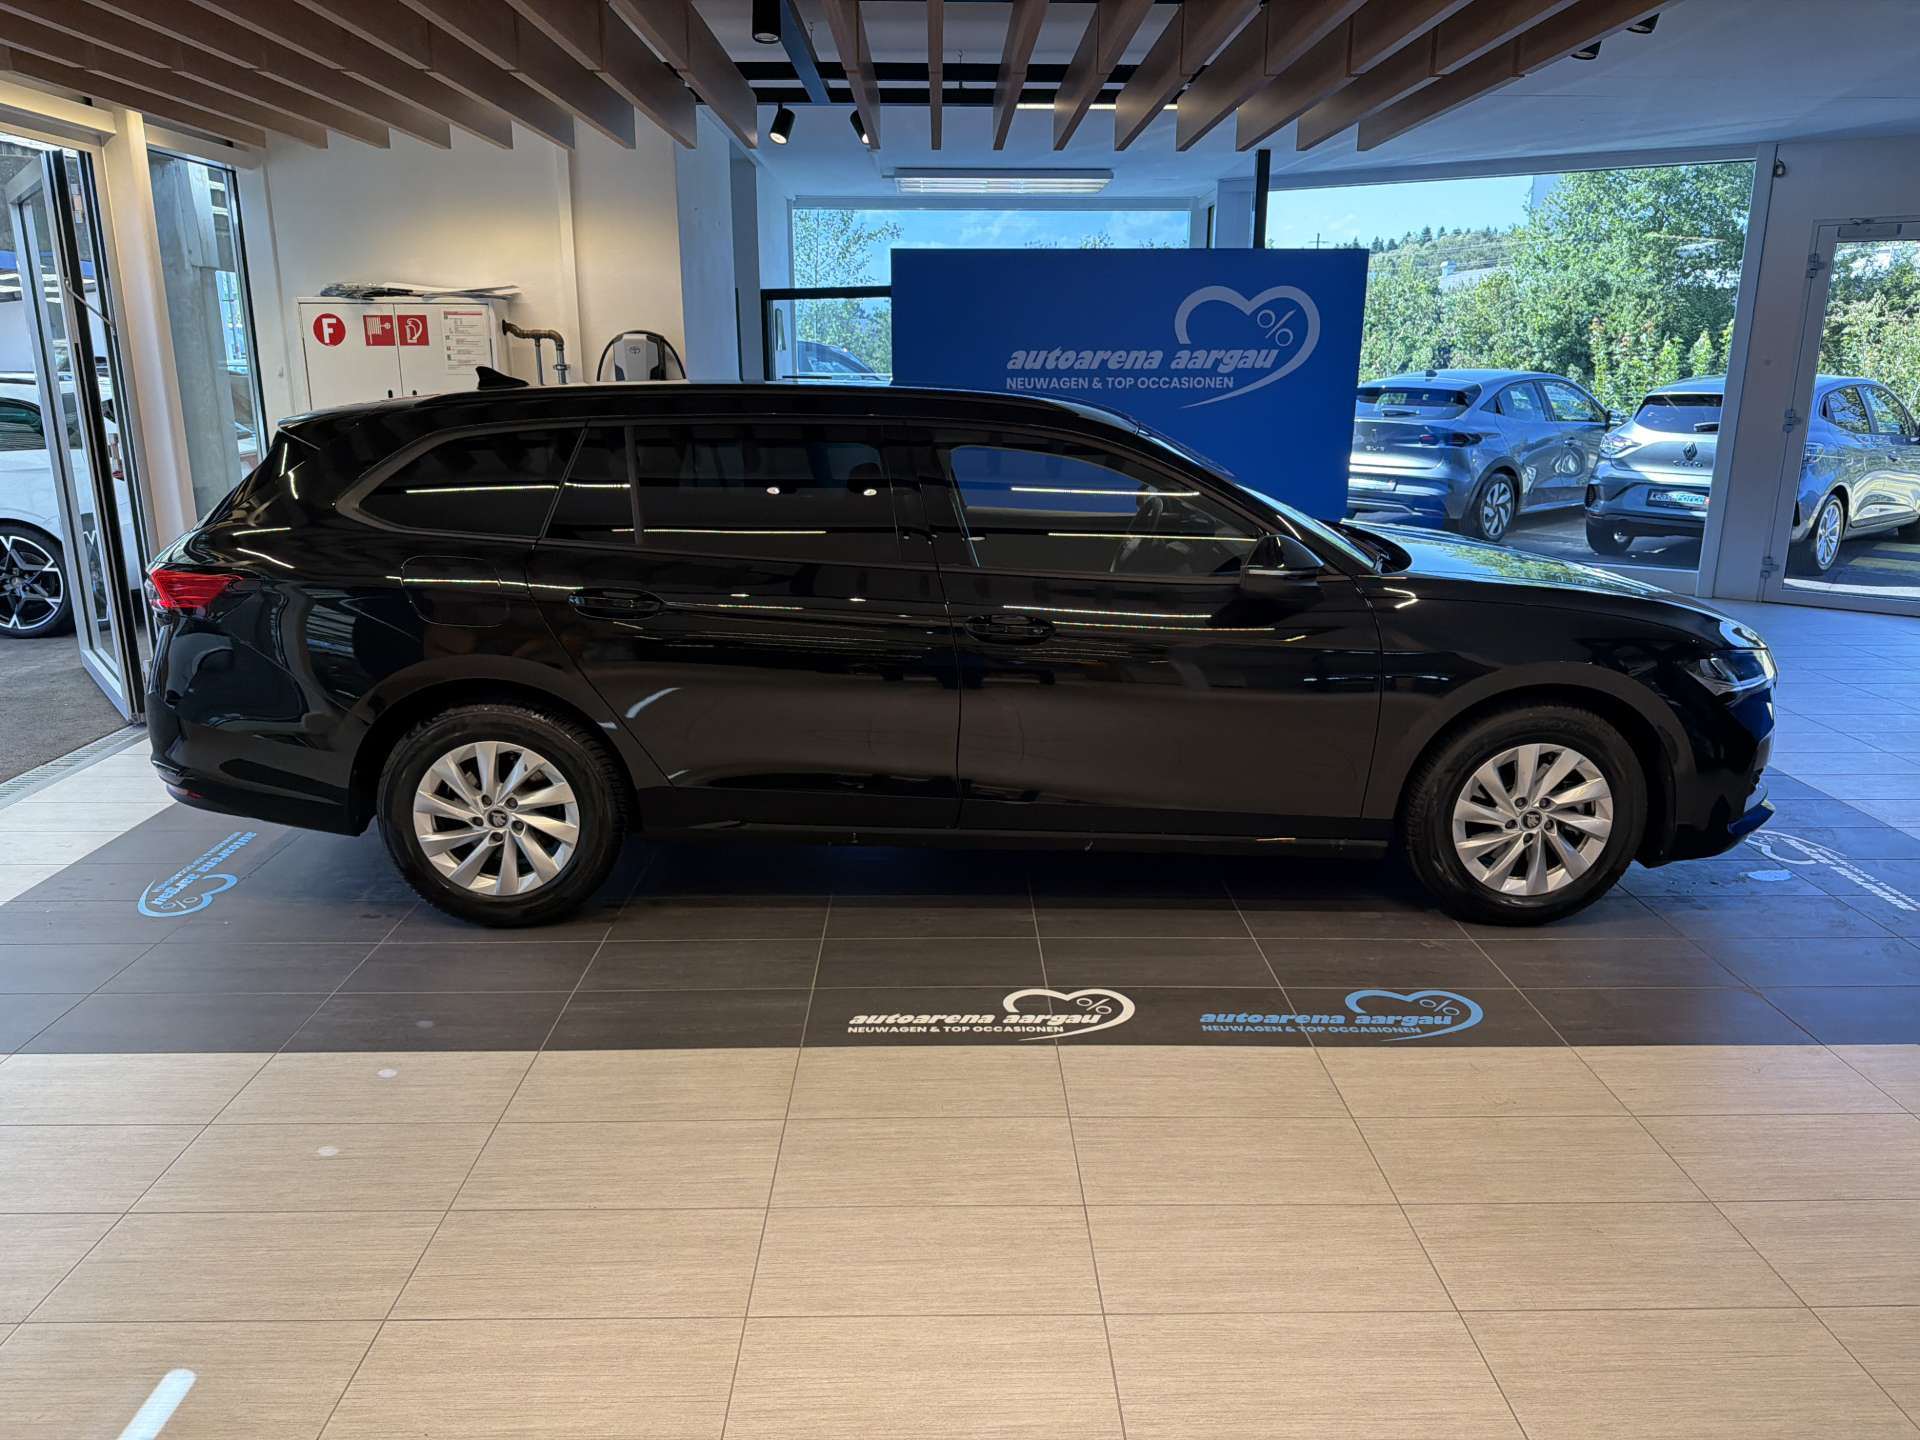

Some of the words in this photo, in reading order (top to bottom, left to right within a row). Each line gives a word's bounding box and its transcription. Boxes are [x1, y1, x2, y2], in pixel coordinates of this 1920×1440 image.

[321, 318, 337, 344] F
[1006, 345, 1164, 371] autoarena
[1170, 348, 1280, 374] aargau
[1005, 376, 1090, 390] NEUWAGEN
[1092, 377, 1103, 390] &
[1106, 376, 1136, 389] TOP
[1137, 375, 1235, 389] OCCASIONEN
[849, 1013, 996, 1025] autoarena
[1002, 1014, 1101, 1026] aargau
[1200, 1012, 1346, 1025] autoarena
[1354, 1013, 1452, 1026] aargau
[847, 1026, 925, 1034] NEUWAGEN
[973, 1025, 1064, 1033] OCCASIONEN
[1202, 1025, 1284, 1033] NEUWAGEN
[1328, 1025, 1422, 1034] OCCASIONEN
